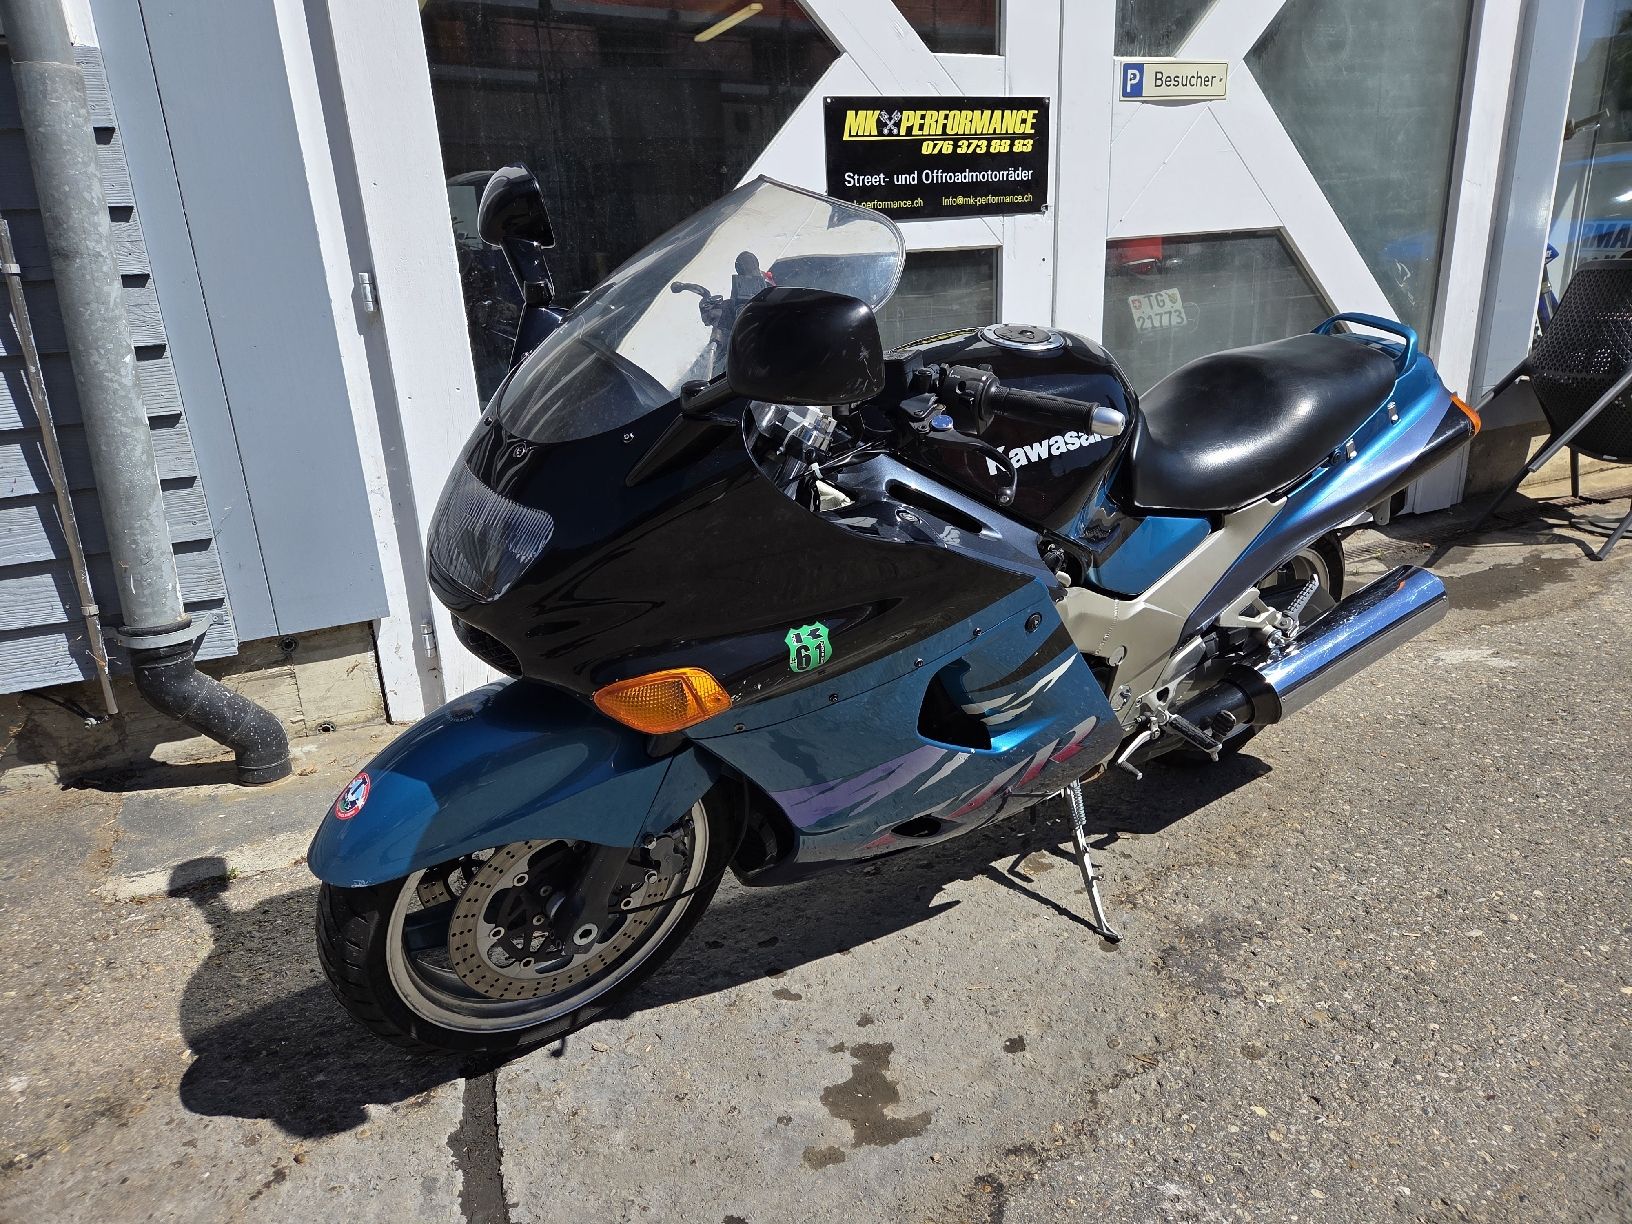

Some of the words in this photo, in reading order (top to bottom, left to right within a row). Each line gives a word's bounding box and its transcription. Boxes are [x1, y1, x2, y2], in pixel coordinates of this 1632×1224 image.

[1126, 69, 1140, 93] P
[1154, 71, 1216, 88] Besucher
[843, 110, 879, 138] MK
[900, 109, 1038, 136] PERFORMANCE
[921, 140, 954, 155] 076
[956, 140, 987, 154] 373
[990, 139, 1010, 154] 88
[1013, 139, 1034, 153] 83
[844, 172, 890, 187] Street-
[894, 170, 918, 185] und
[922, 167, 1033, 184] Offroadmotorräder
[854, 198, 924, 209] performance.ch
[1143, 293, 1166, 311] TG
[1137, 309, 1185, 331] 21773
[984, 430, 1114, 476] Kawasa
[796, 640, 826, 671] 61
